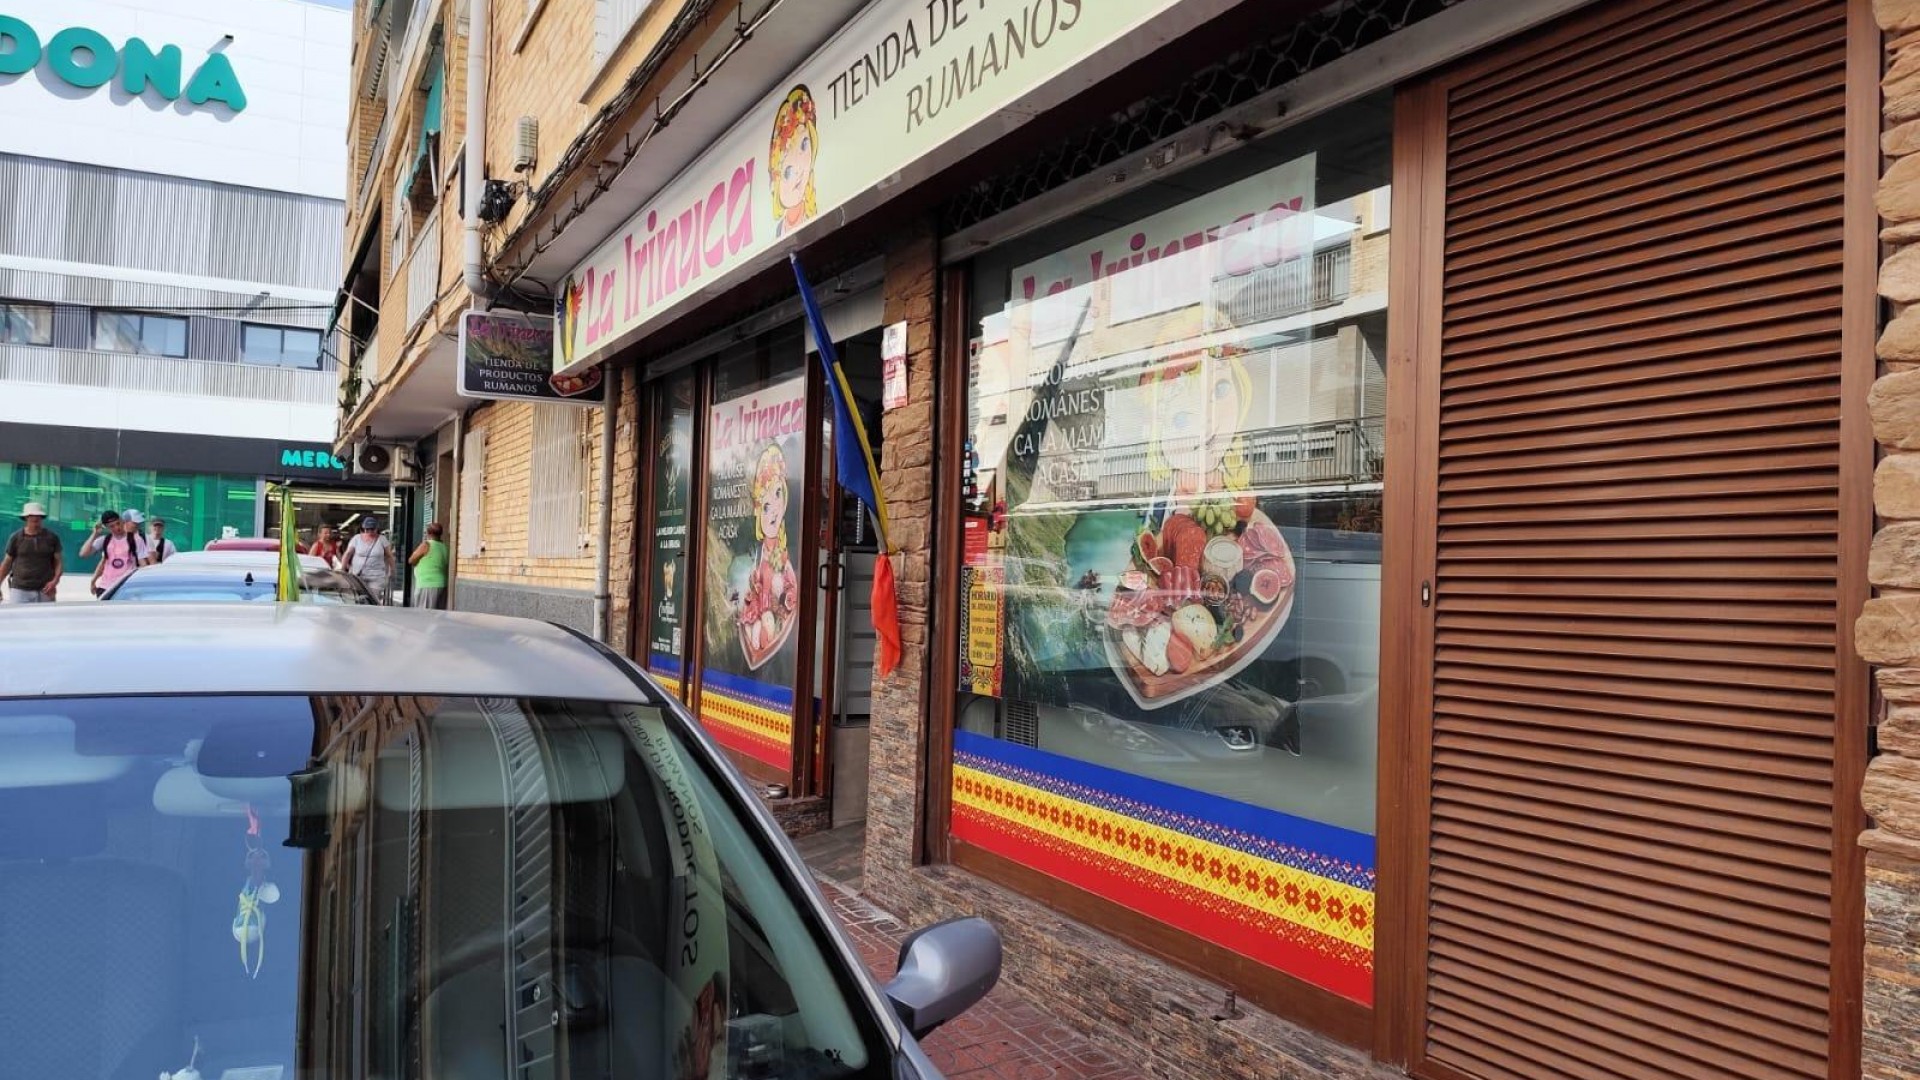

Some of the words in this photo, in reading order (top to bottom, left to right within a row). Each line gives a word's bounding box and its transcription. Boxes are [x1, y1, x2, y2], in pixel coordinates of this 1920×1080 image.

[827, 18, 921, 121] TIENDA
[905, 0, 1082, 134] RUMANOS
[586, 266, 617, 346] La
[624, 157, 755, 323] Irinuca
[480, 369, 543, 383] PRODUCTOS
[485, 357, 523, 369] TIENDA
[525, 360, 540, 370] DE
[484, 381, 538, 394] RUMANOS
[714, 412, 733, 450] La
[739, 399, 804, 444] Irinuca
[1037, 430, 1058, 453] LA
